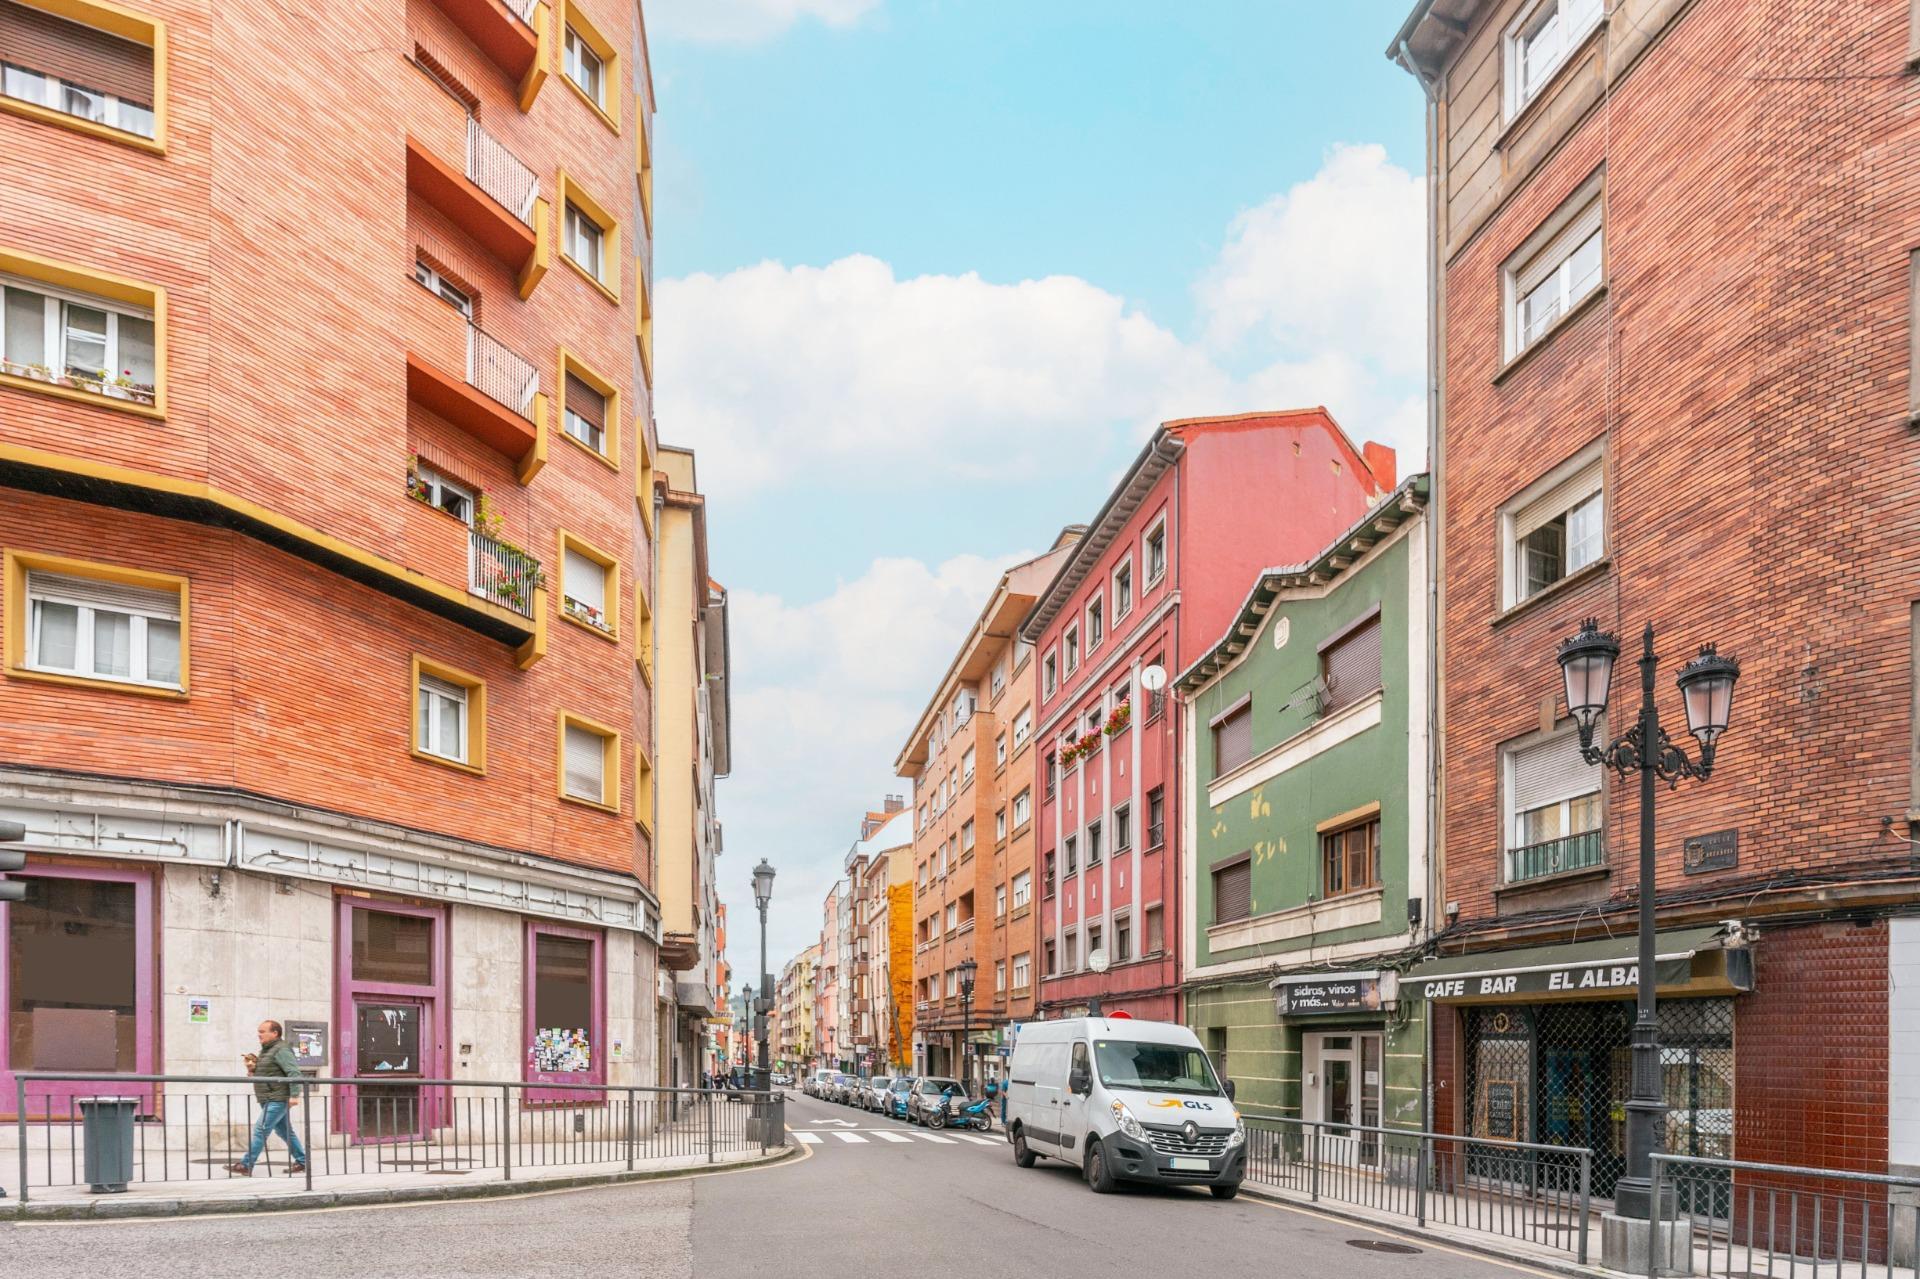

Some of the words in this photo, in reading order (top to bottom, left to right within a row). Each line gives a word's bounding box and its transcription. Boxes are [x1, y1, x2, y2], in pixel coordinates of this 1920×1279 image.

[1294, 986, 1326, 997] sidras,
[1328, 984, 1356, 995] vinos
[1424, 980, 1465, 998] CAFE
[1479, 976, 1517, 994] BAR
[1548, 972, 1574, 990] EL
[1292, 999, 1298, 1010] y
[1300, 996, 1329, 1008] más...
[1183, 1101, 1213, 1111] GLS
